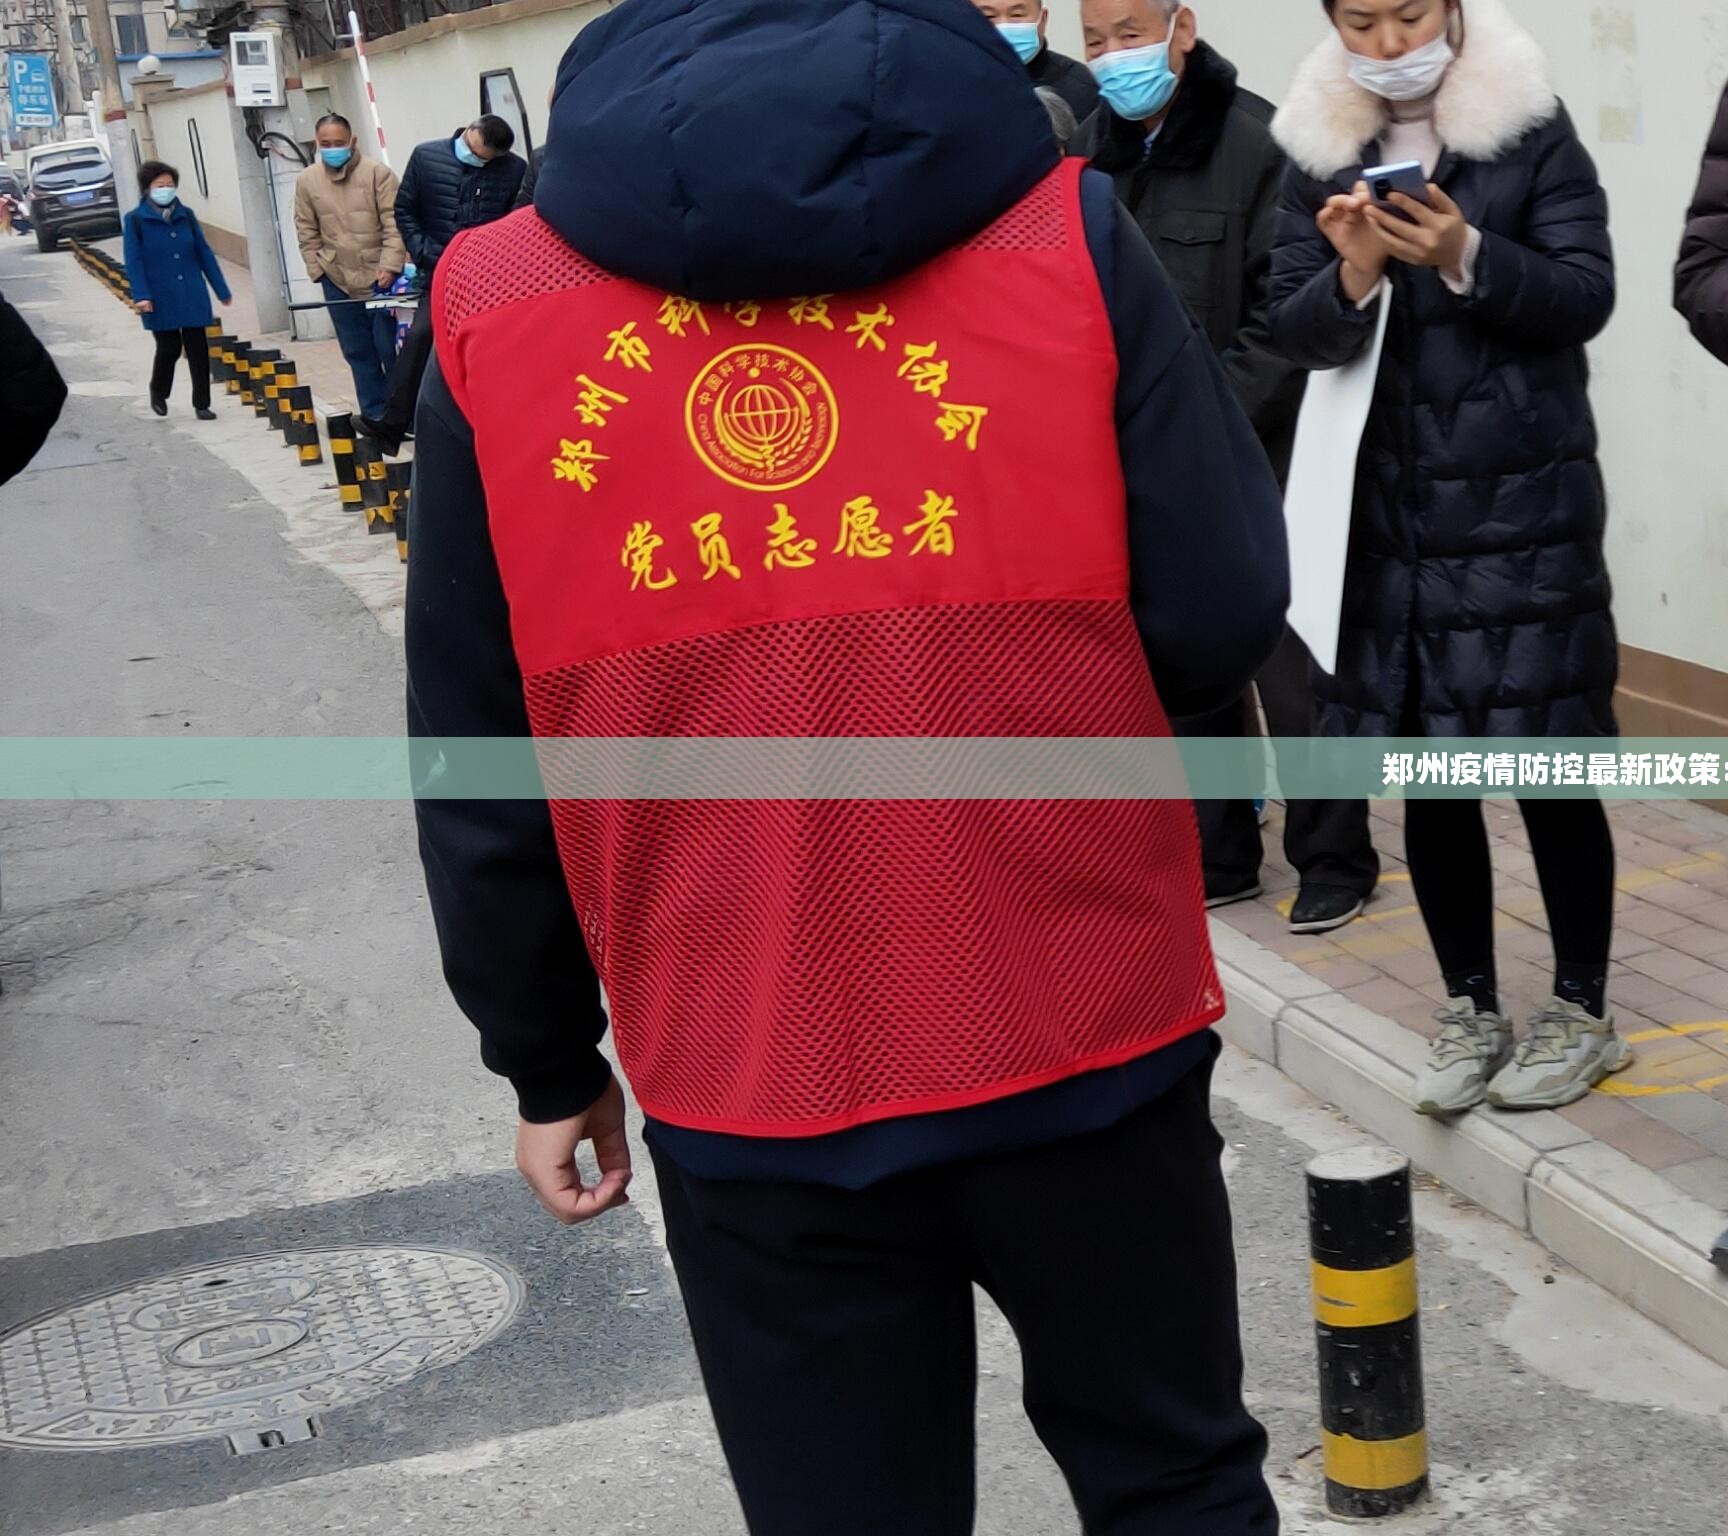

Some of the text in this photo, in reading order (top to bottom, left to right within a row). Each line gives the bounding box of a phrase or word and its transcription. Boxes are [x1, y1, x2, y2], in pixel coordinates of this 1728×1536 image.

[14, 61, 27, 83] P
[620, 488, 959, 591] 党员志愿者
